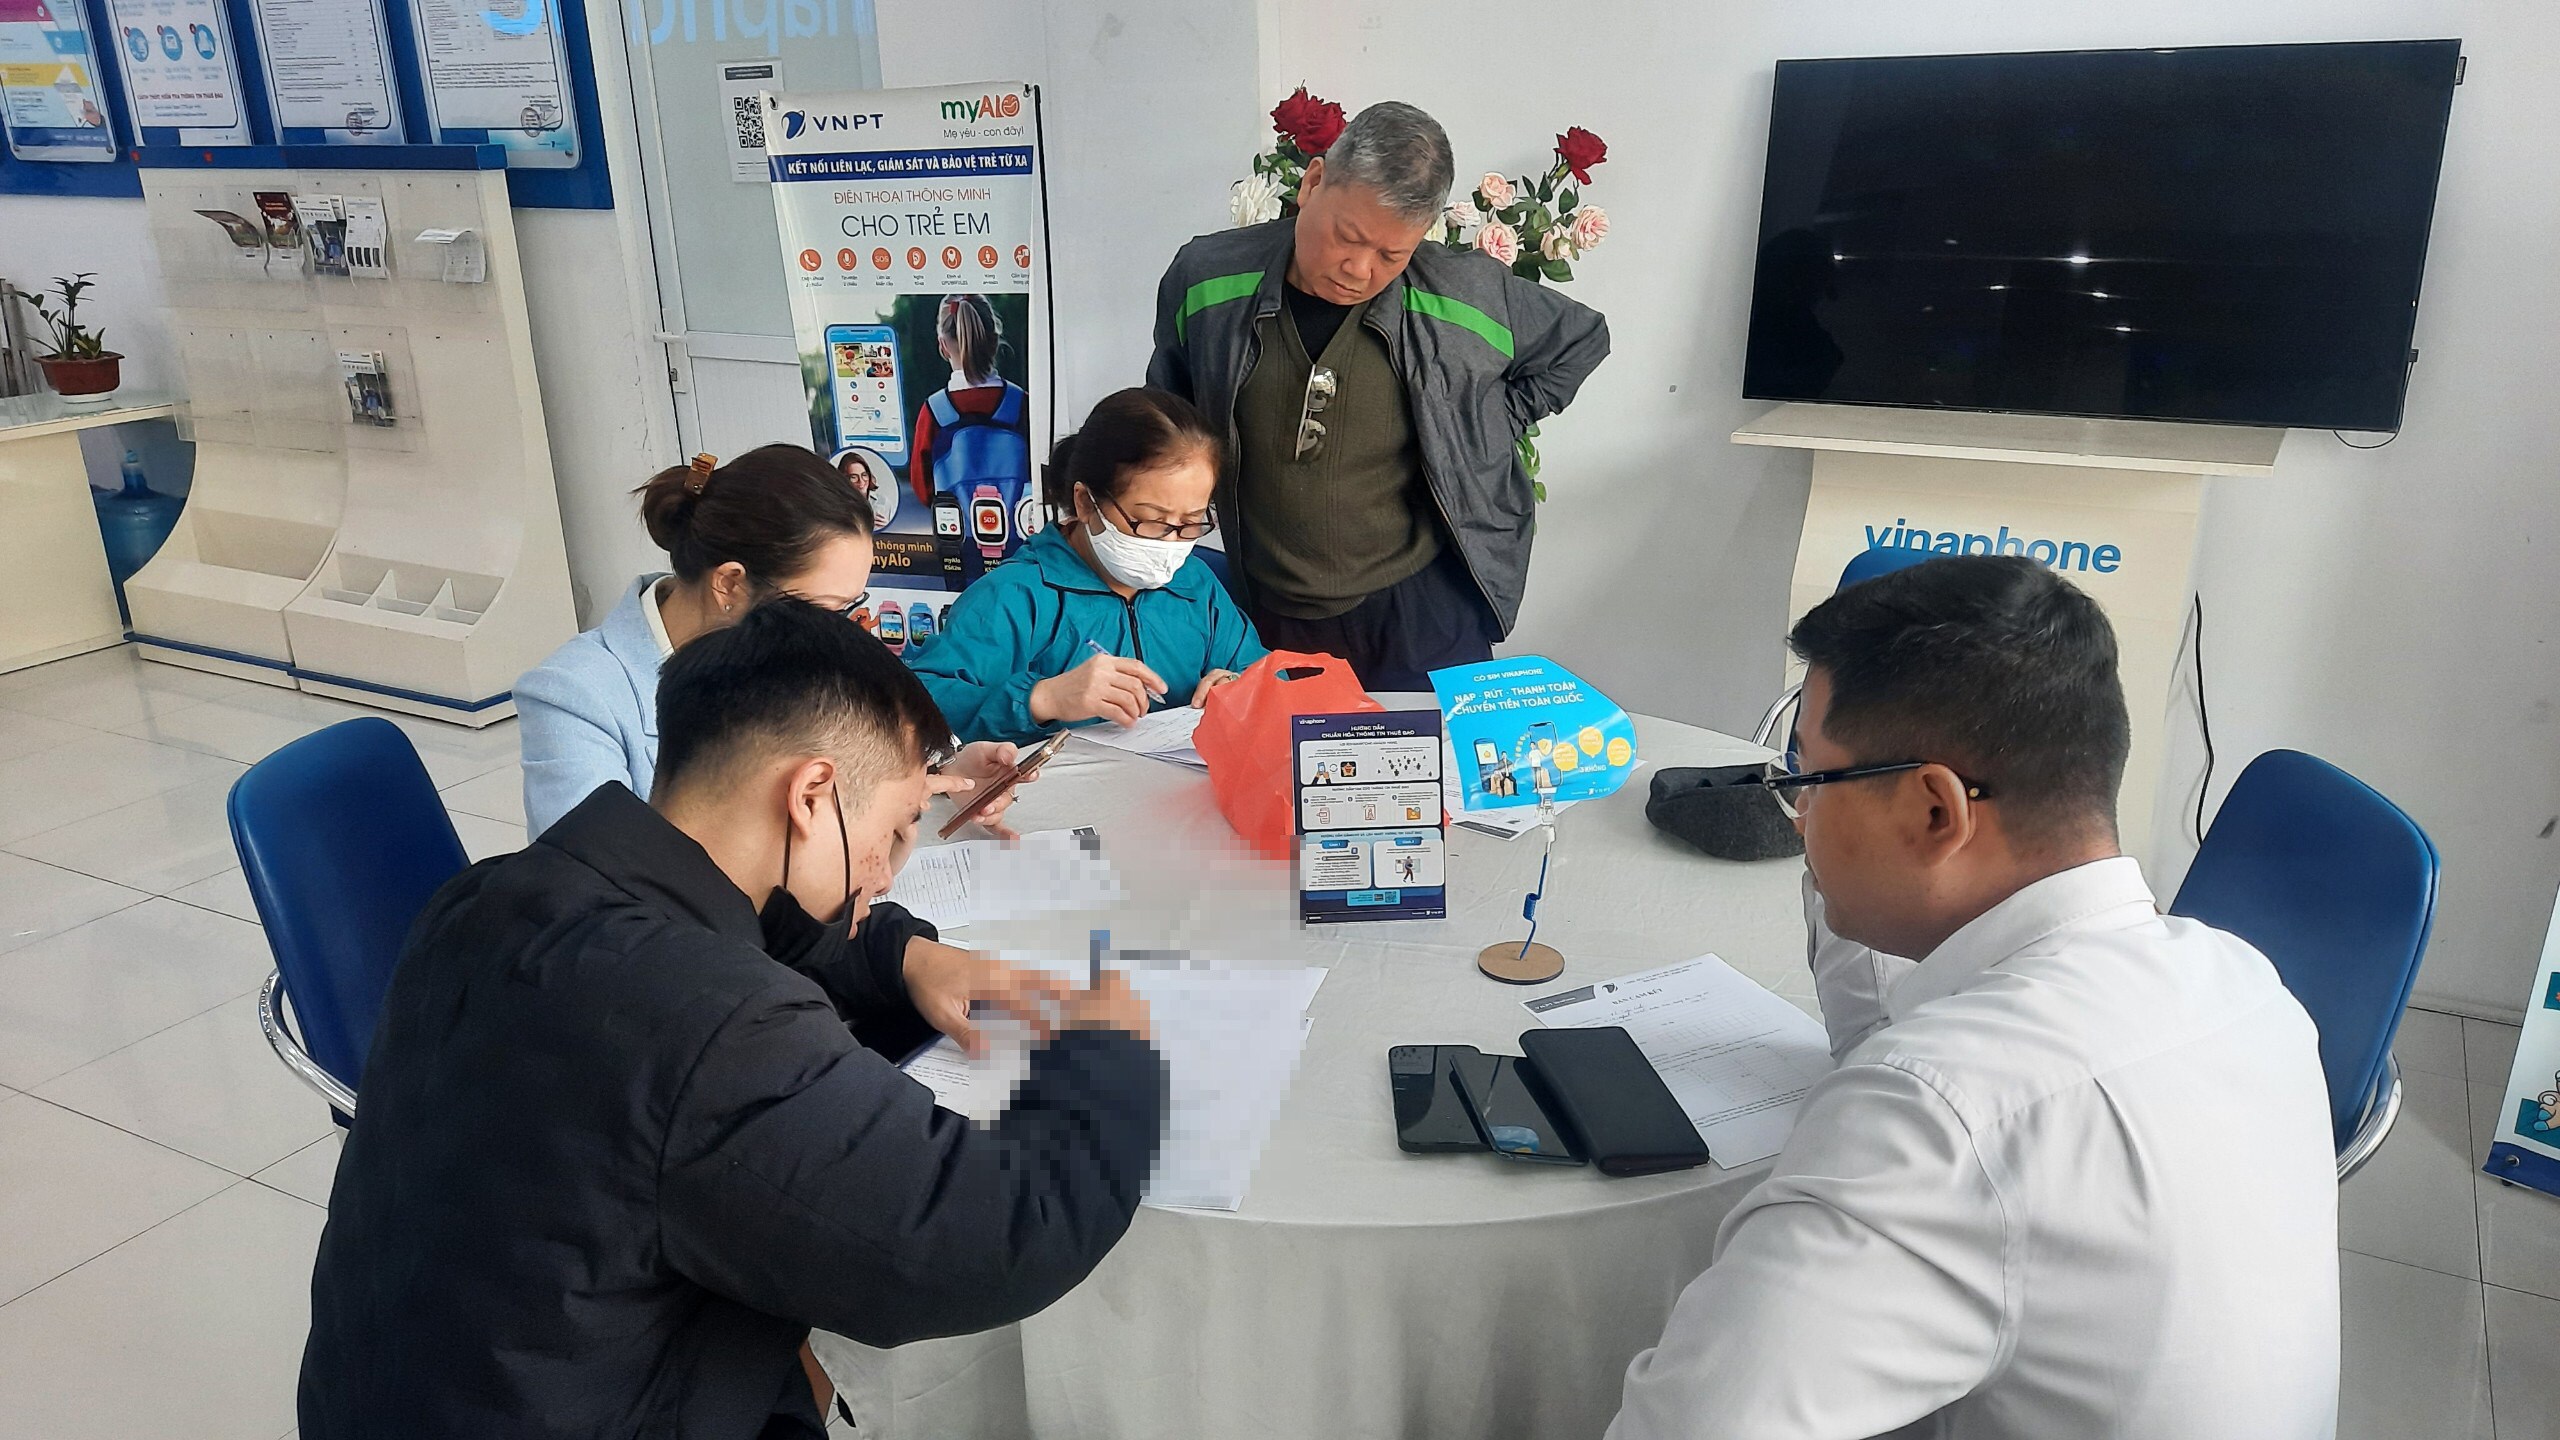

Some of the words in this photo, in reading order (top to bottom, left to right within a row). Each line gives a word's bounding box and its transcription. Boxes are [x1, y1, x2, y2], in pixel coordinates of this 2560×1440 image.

[812, 114, 884, 131] VNPT
[983, 129, 1001, 137] con
[788, 159, 807, 175] KẾT
[810, 158, 828, 174] NỐI
[831, 159, 853, 173] LIÊN
[855, 160, 876, 175] LẠC,
[877, 157, 904, 172] GIÁM
[906, 156, 924, 171] SÁT
[925, 155, 940, 170] VÀ
[942, 153, 962, 170] BẢO
[963, 154, 977, 171] VỆ
[978, 152, 998, 168] TRẺ
[998, 153, 1013, 167] TỪ
[1014, 154, 1028, 167] XA
[865, 191, 904, 205] THOẠI
[906, 188, 954, 202] THÔNG
[957, 188, 991, 201] MINH
[841, 214, 899, 237] CHO
[905, 206, 945, 236] TRẺ
[953, 212, 990, 235] EM
[875, 255, 889, 263] SOS
[983, 516, 996, 524] SOS
[875, 540, 905, 553] thông
[908, 541, 933, 552] minh
[1864, 518, 2122, 574] vinaphone
[1501, 668, 1544, 679] VINAPHONE
[1483, 688, 1503, 700] RÚT
[1511, 684, 1546, 696] THANH
[1548, 680, 1577, 692] TOÁN
[1498, 698, 1520, 710] TIỀN
[1522, 695, 1551, 707] TOÀN
[1552, 691, 1585, 704] QUỐC
